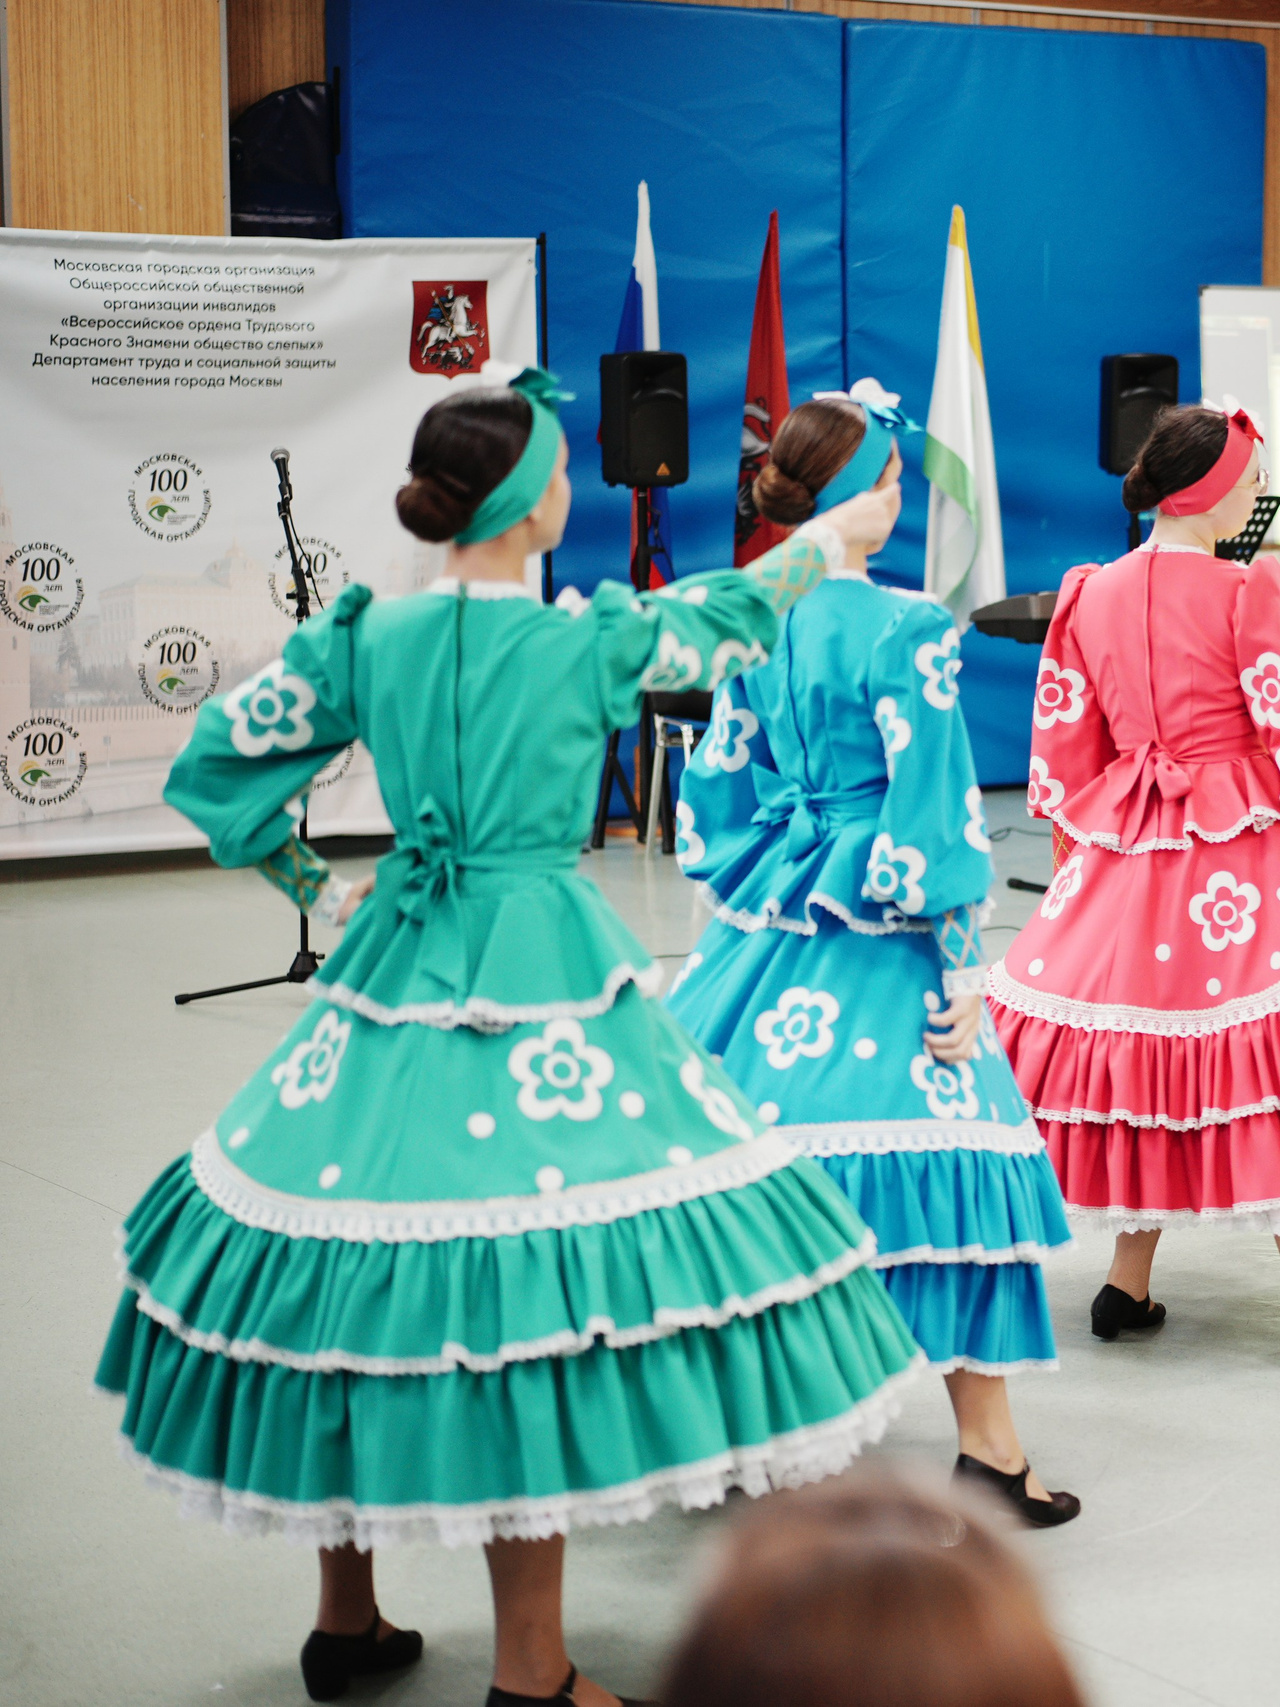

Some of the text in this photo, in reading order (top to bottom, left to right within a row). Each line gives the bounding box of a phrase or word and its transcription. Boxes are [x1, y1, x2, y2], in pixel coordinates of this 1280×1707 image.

[53, 258, 316, 277] Московская городская организация
[69, 277, 305, 295] Общероссийской общественной
[103, 299, 277, 314] организации инвалидов
[60, 315, 316, 333] «Всероссийское ордена Трудового
[49, 333, 324, 352] Красного Знамени общество слепых»
[32, 352, 337, 371] Департамент труда и социальной защиты
[91, 375, 283, 389] населения города Москвы
[134, 453, 202, 477] МОСКОВСКАЯ
[150, 468, 188, 492] 100
[128, 489, 164, 541] ГОРОДСКАЯ
[5, 542, 75, 566] МОСКОВСКАЯ
[275, 537, 342, 560] МООВСКАЯ
[22, 557, 61, 582] 100
[299, 551, 327, 576] 00
[268, 572, 297, 620] ГОРОДСКА
[143, 627, 211, 650] МОСКОВСКАЯ
[159, 641, 197, 665] 100
[7, 717, 79, 742] МОСКОВСКАЯ
[23, 731, 64, 757] 100
